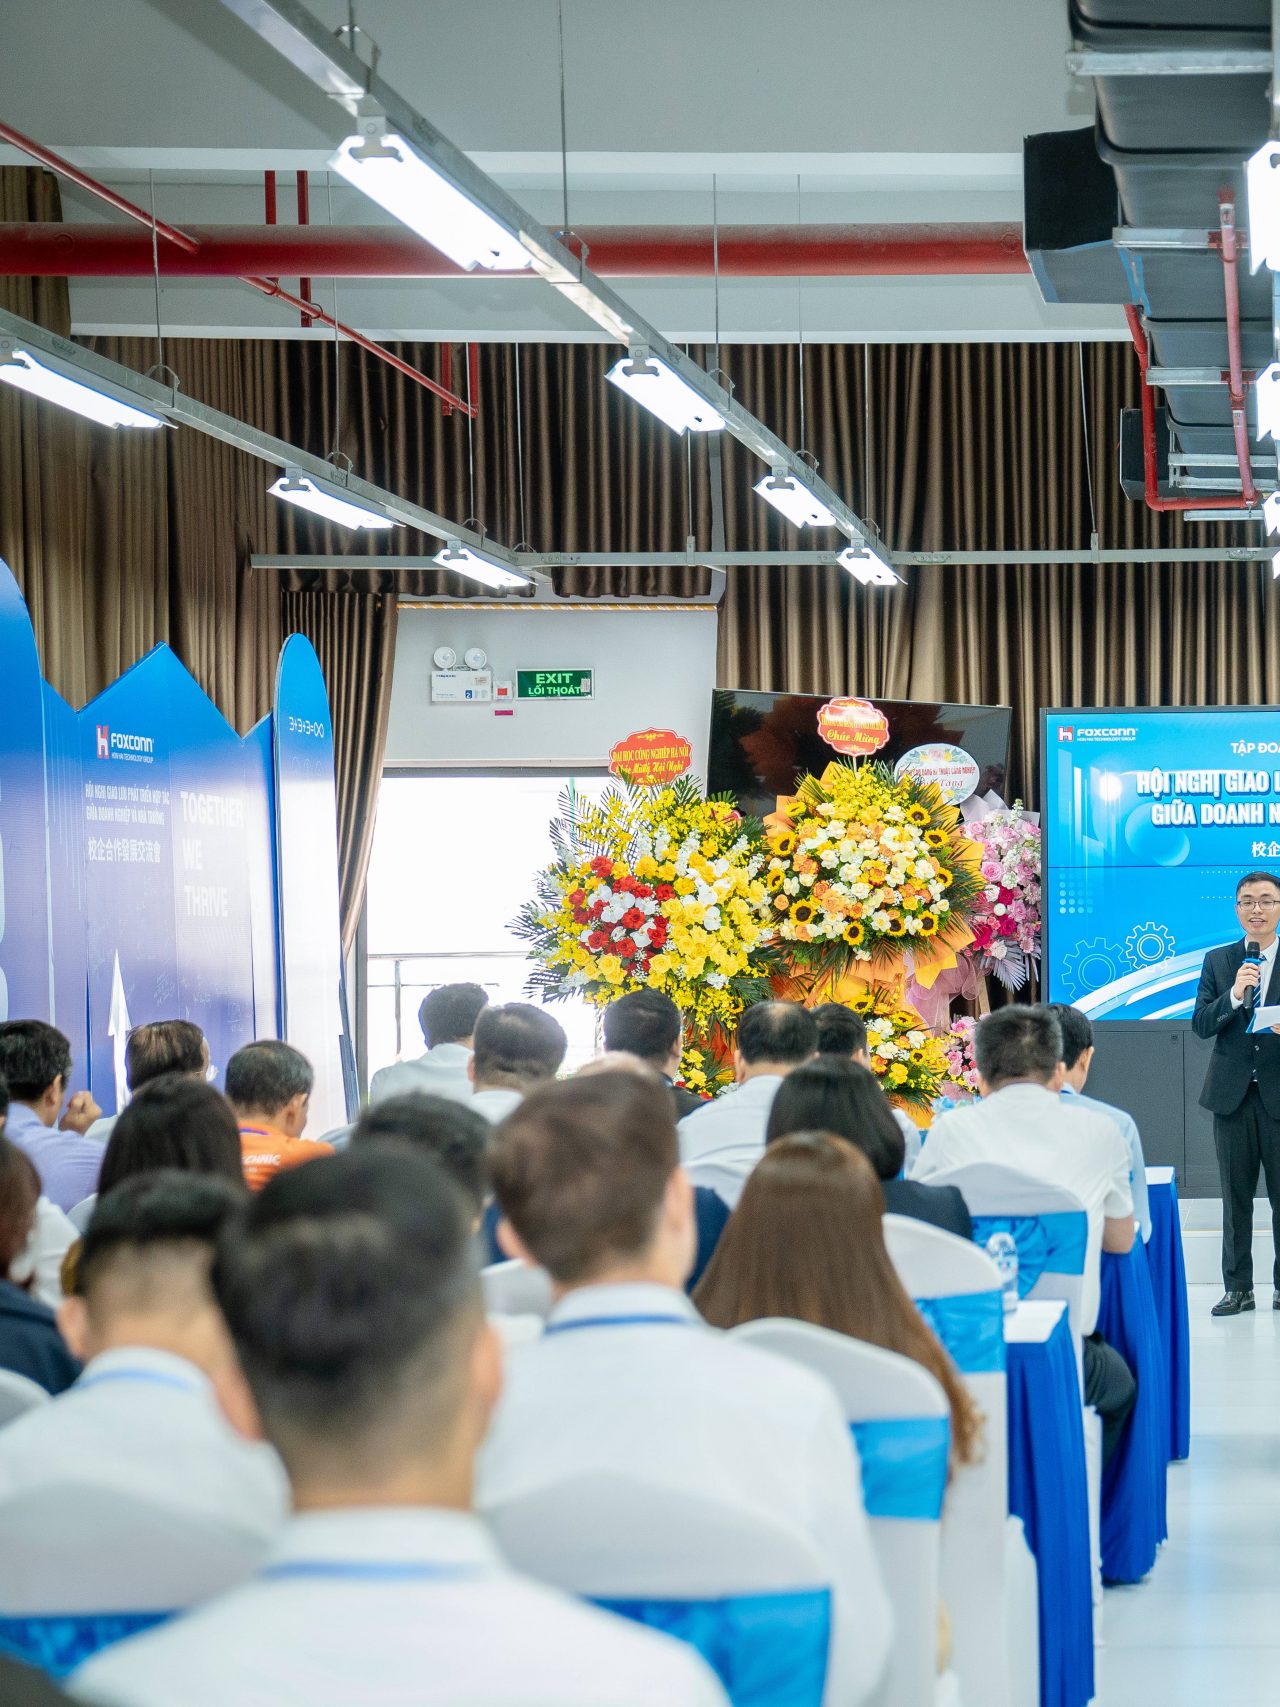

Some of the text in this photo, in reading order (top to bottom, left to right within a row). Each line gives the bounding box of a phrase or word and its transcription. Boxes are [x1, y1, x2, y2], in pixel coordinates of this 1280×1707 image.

[528, 684, 545, 695] LỐI
[547, 685, 581, 695] THOÁT
[536, 673, 573, 684] EXIT
[111, 732, 153, 753] FOXCONN
[1077, 728, 1136, 737] FOXCONN
[1231, 739, 1255, 756] TẬP
[1136, 766, 1170, 798] HỘI
[1174, 770, 1221, 798] NGHỊ
[1224, 770, 1270, 793] GIAO
[181, 791, 245, 828] TOGETHER
[1151, 798, 1197, 825] GIỮA
[1201, 802, 1265, 825] DOANH
[183, 838, 203, 870] WE
[184, 885, 229, 917] THRIVE
